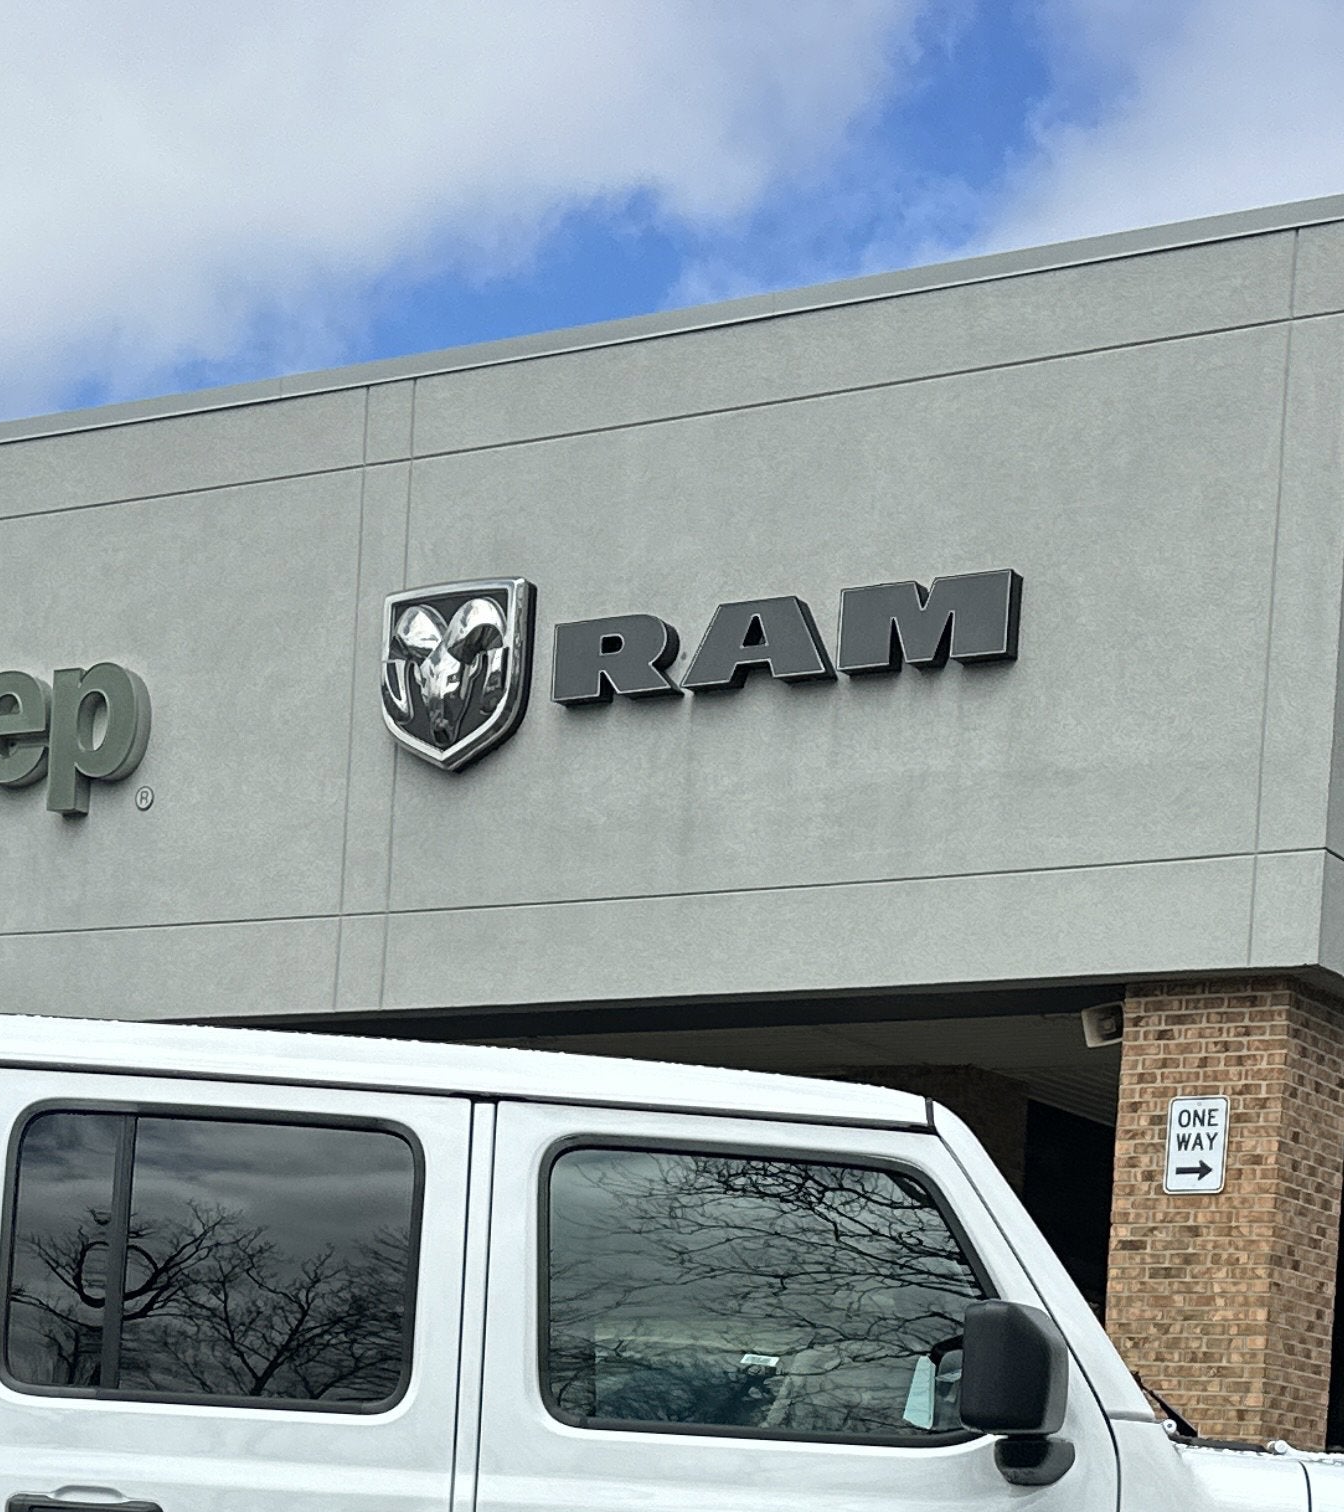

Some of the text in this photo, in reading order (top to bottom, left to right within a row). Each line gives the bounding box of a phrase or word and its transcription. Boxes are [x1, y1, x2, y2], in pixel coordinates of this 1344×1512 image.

[551, 568, 1020, 705] RAM
[1177, 1107, 1220, 1128] ONE
[1176, 1131, 1219, 1152] WAY
